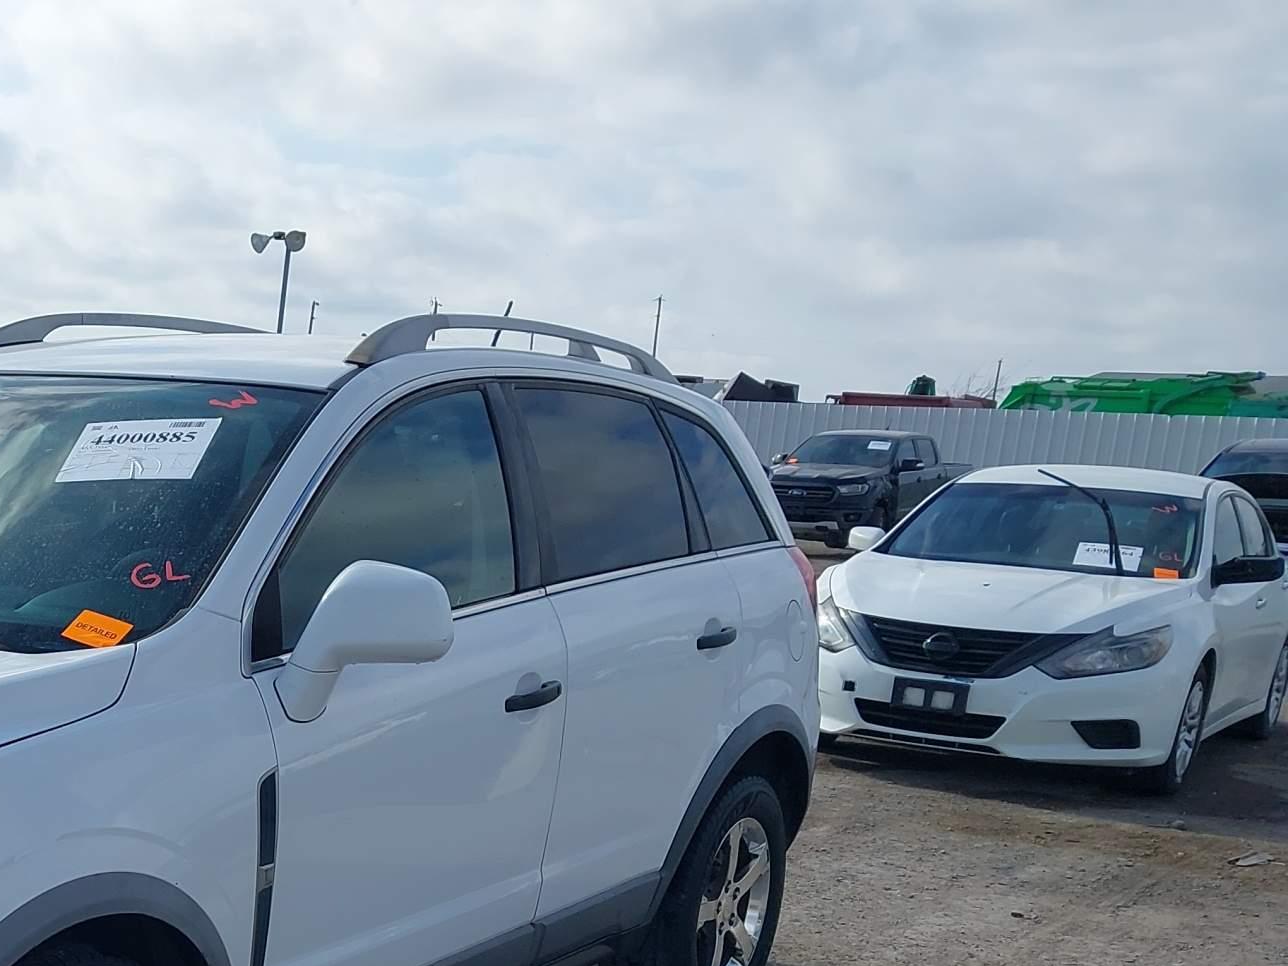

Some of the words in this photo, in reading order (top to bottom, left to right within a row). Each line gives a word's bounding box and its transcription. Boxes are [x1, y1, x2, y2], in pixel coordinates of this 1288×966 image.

[91, 431, 199, 446] 44000885
[130, 560, 192, 589] GL
[75, 621, 118, 641] DETAILED
